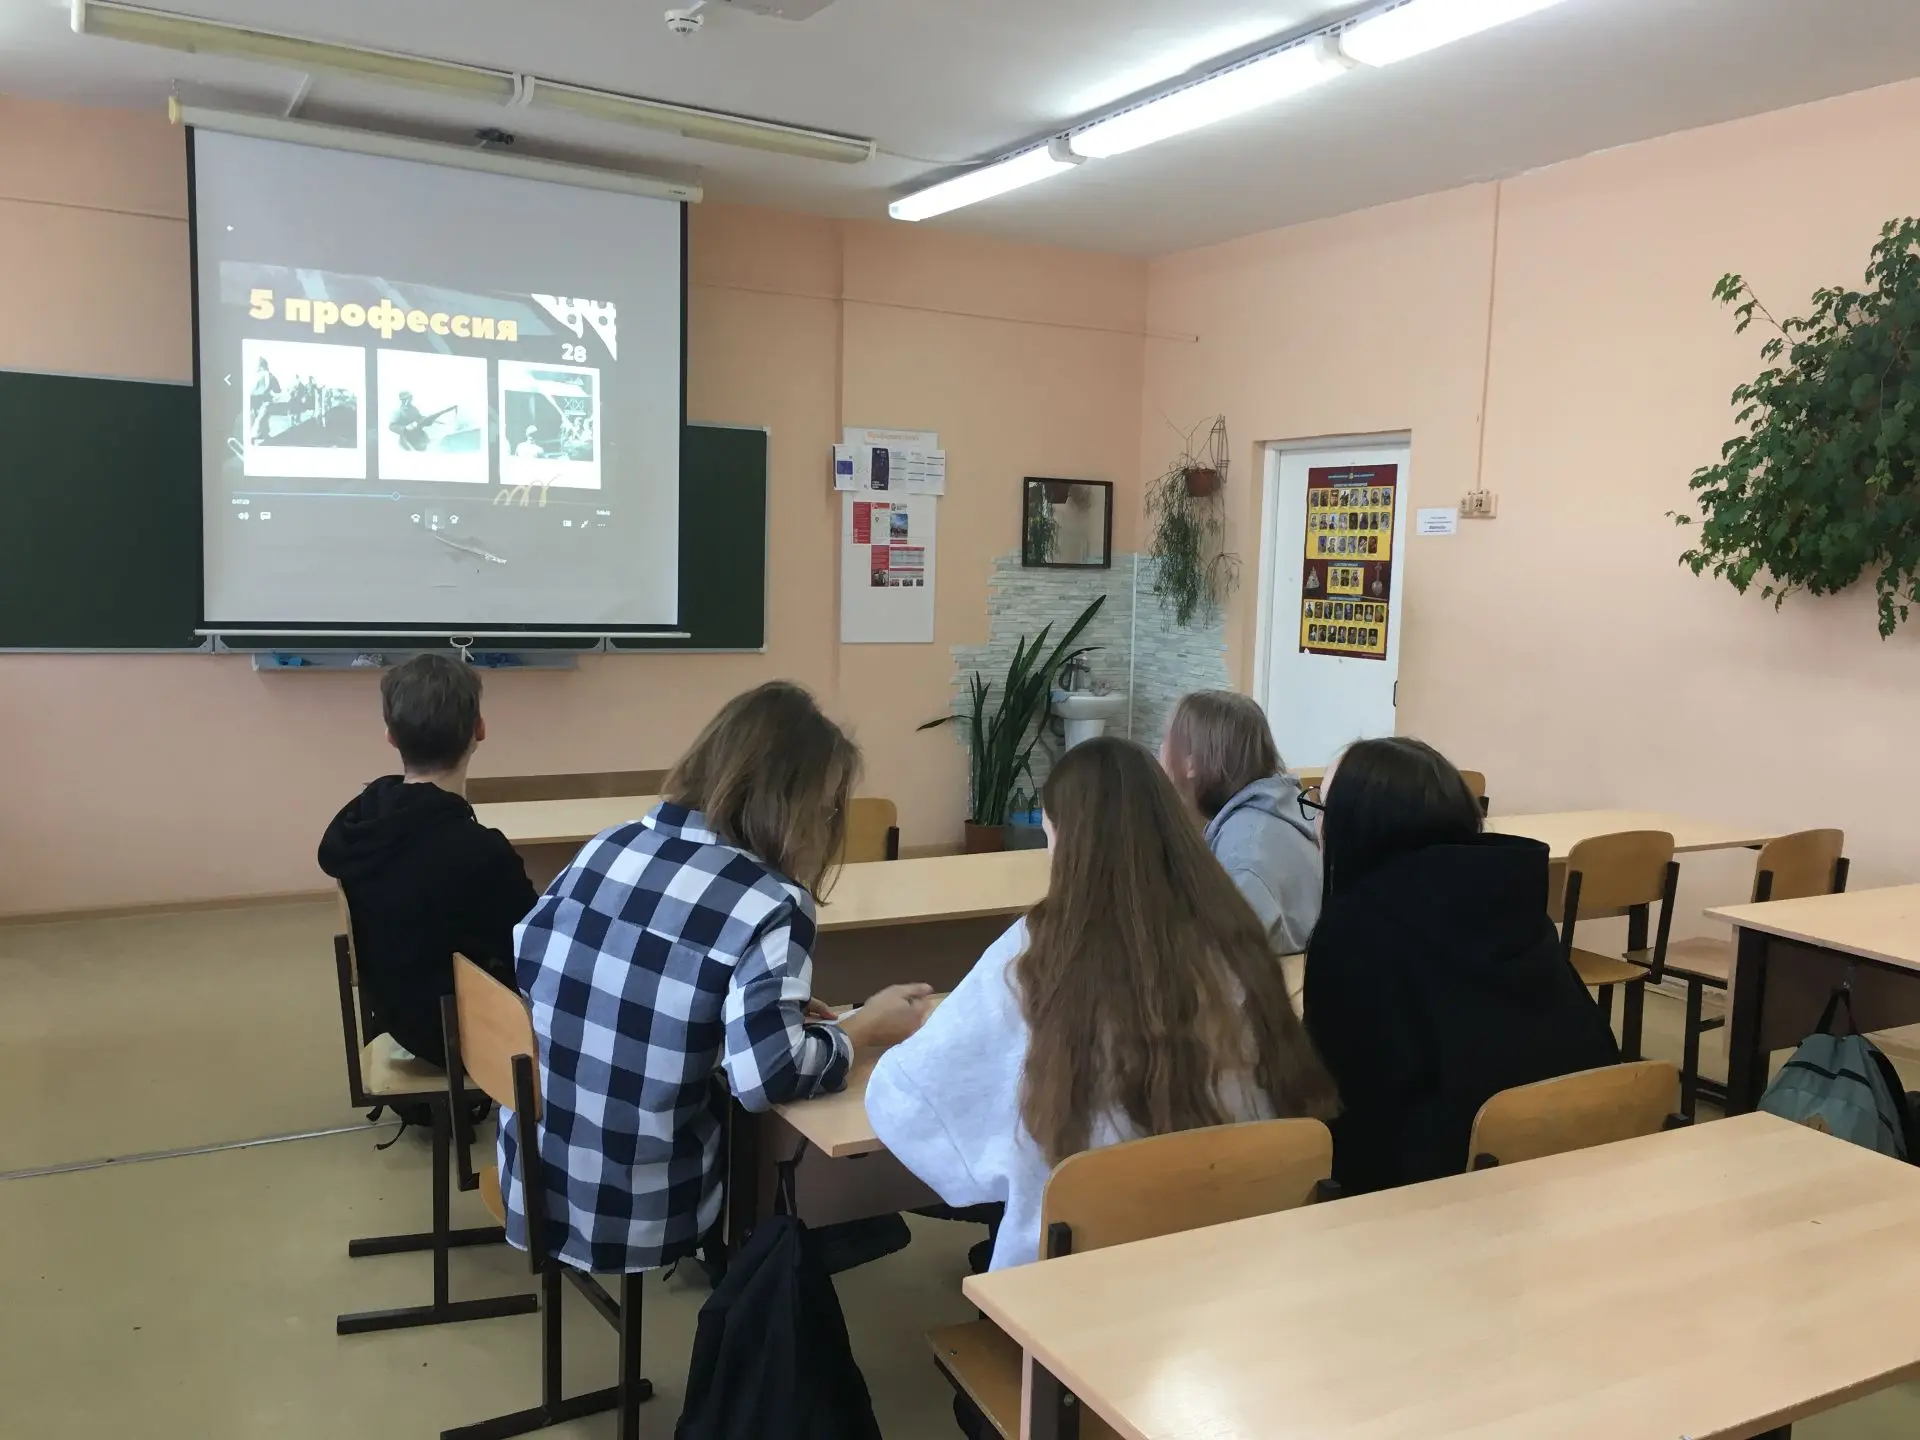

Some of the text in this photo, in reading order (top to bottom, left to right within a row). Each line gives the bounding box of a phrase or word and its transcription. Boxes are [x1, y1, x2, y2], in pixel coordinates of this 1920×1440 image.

[249, 288, 518, 342] 5 профессия
[561, 342, 587, 363] 28
